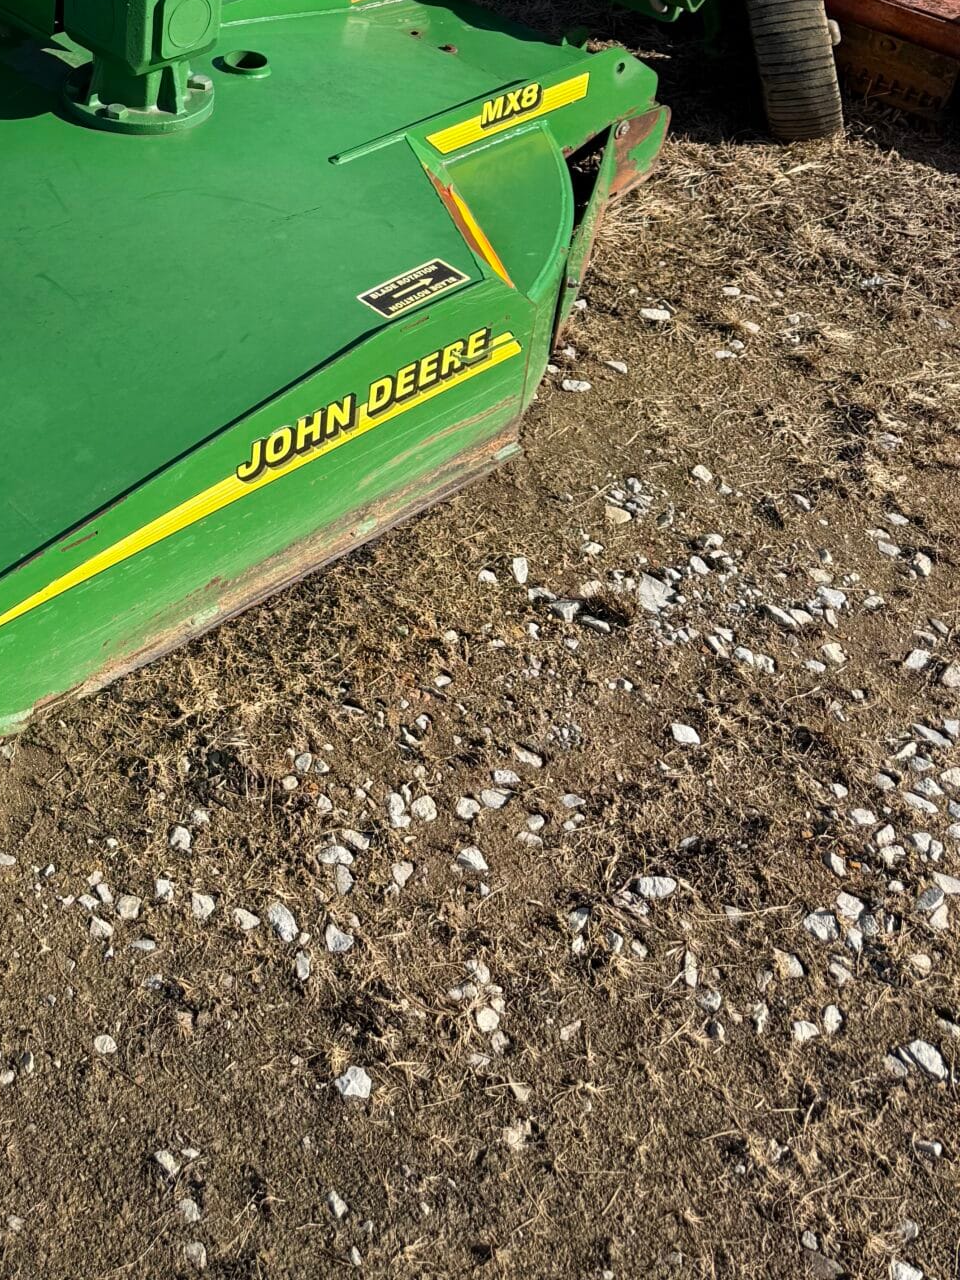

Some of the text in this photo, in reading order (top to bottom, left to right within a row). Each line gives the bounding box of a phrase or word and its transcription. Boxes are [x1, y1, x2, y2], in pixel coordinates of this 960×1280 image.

[481, 82, 541, 128] MX8
[368, 264, 438, 300] BLADE ROTATION
[388, 276, 458, 312] BLADE ROTATION
[237, 328, 489, 481] JOHN DEERE
